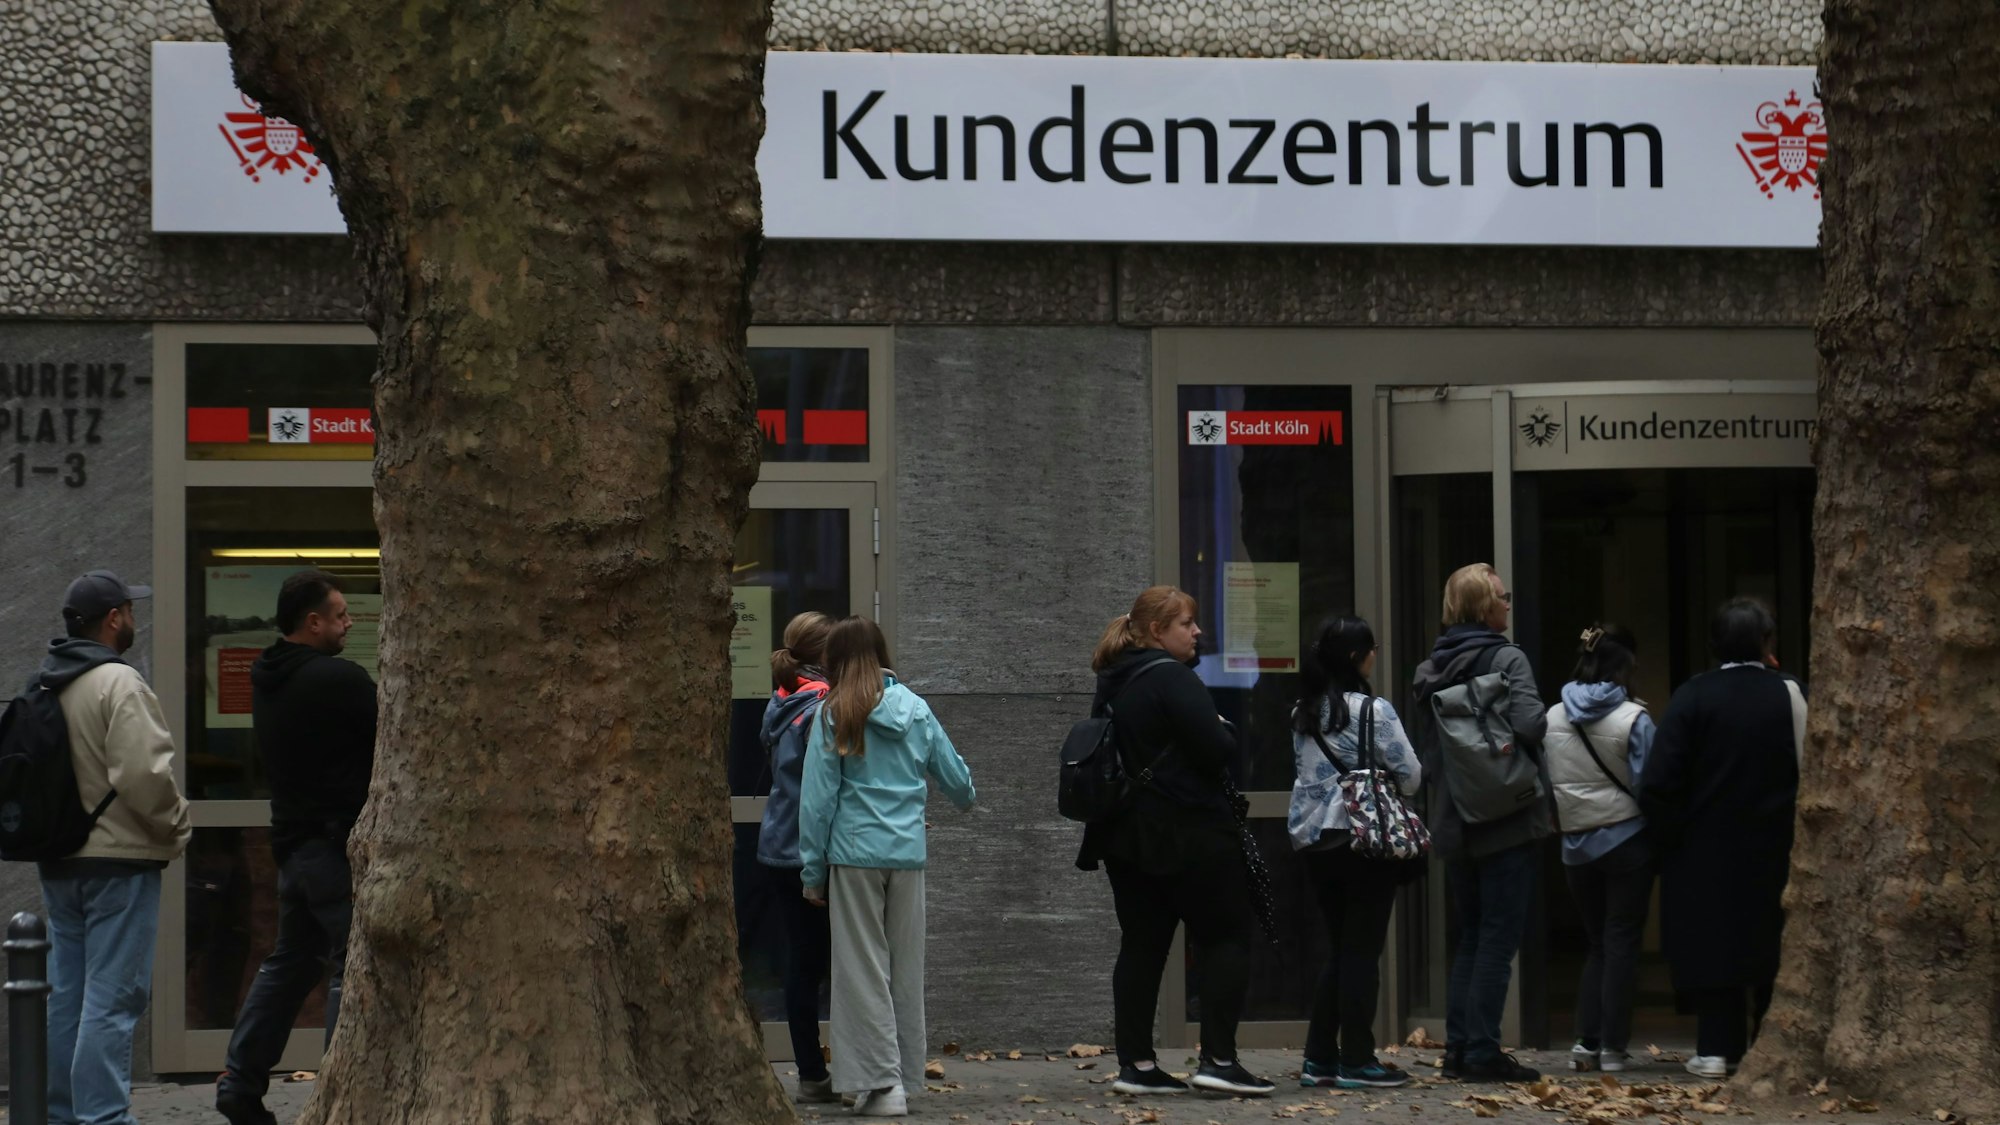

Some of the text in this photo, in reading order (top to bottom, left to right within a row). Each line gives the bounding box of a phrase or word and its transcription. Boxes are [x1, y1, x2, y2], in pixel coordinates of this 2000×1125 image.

[823, 84, 1664, 189] Kundenzentrum
[312, 418, 356, 433] Stadt
[1229, 420, 1309, 436] Stadt Köln
[1580, 411, 1817, 441] Kundenzentrum
